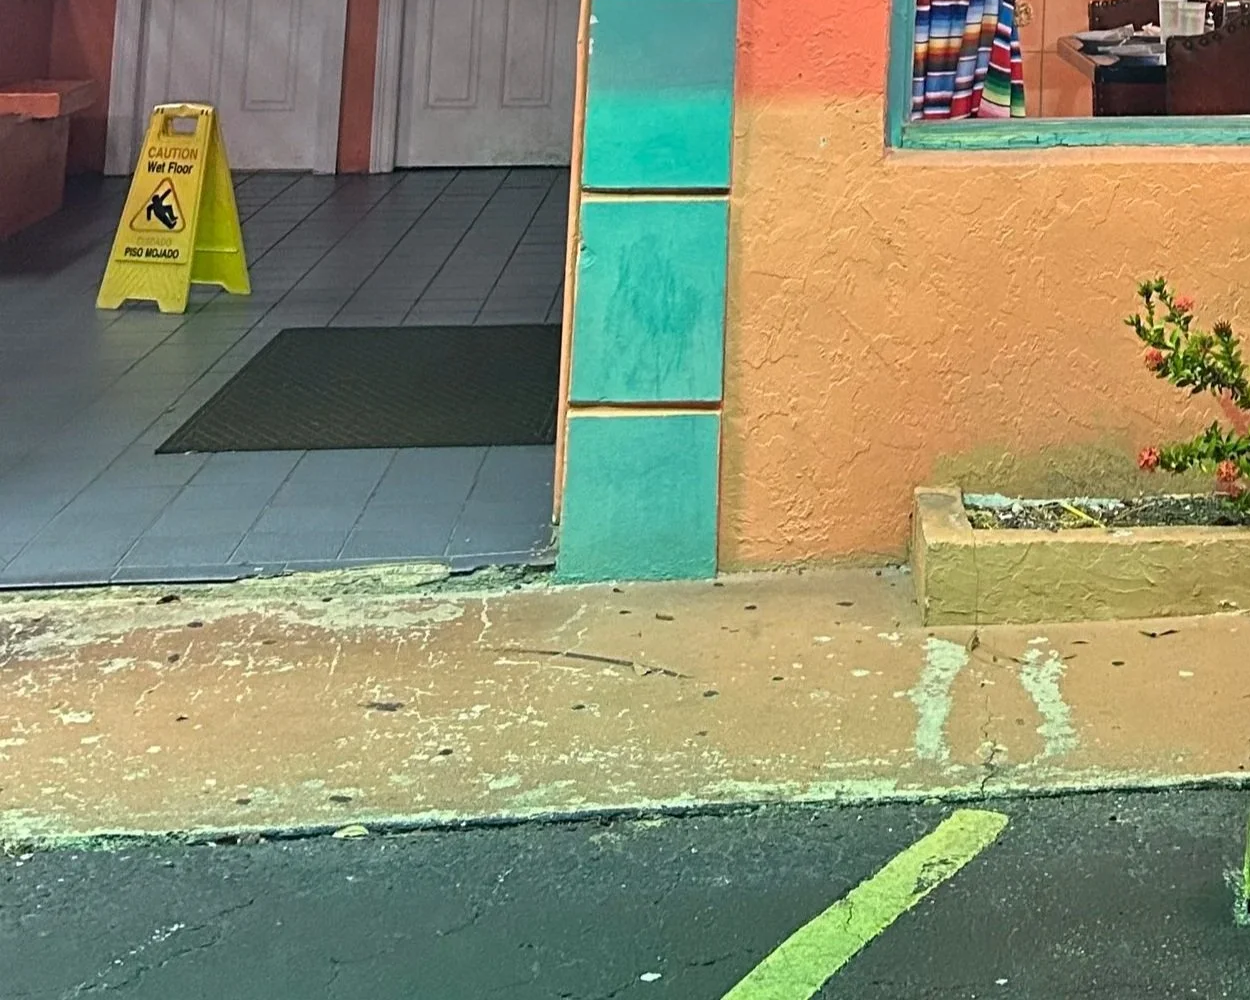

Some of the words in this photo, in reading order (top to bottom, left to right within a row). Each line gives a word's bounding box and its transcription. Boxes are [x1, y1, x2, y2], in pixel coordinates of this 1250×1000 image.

[148, 146, 199, 160] CAUTION
[147, 161, 166, 174] Wet
[168, 162, 194, 175] Floor
[124, 246, 143, 257] PISO
[145, 247, 180, 259] MOJADO
